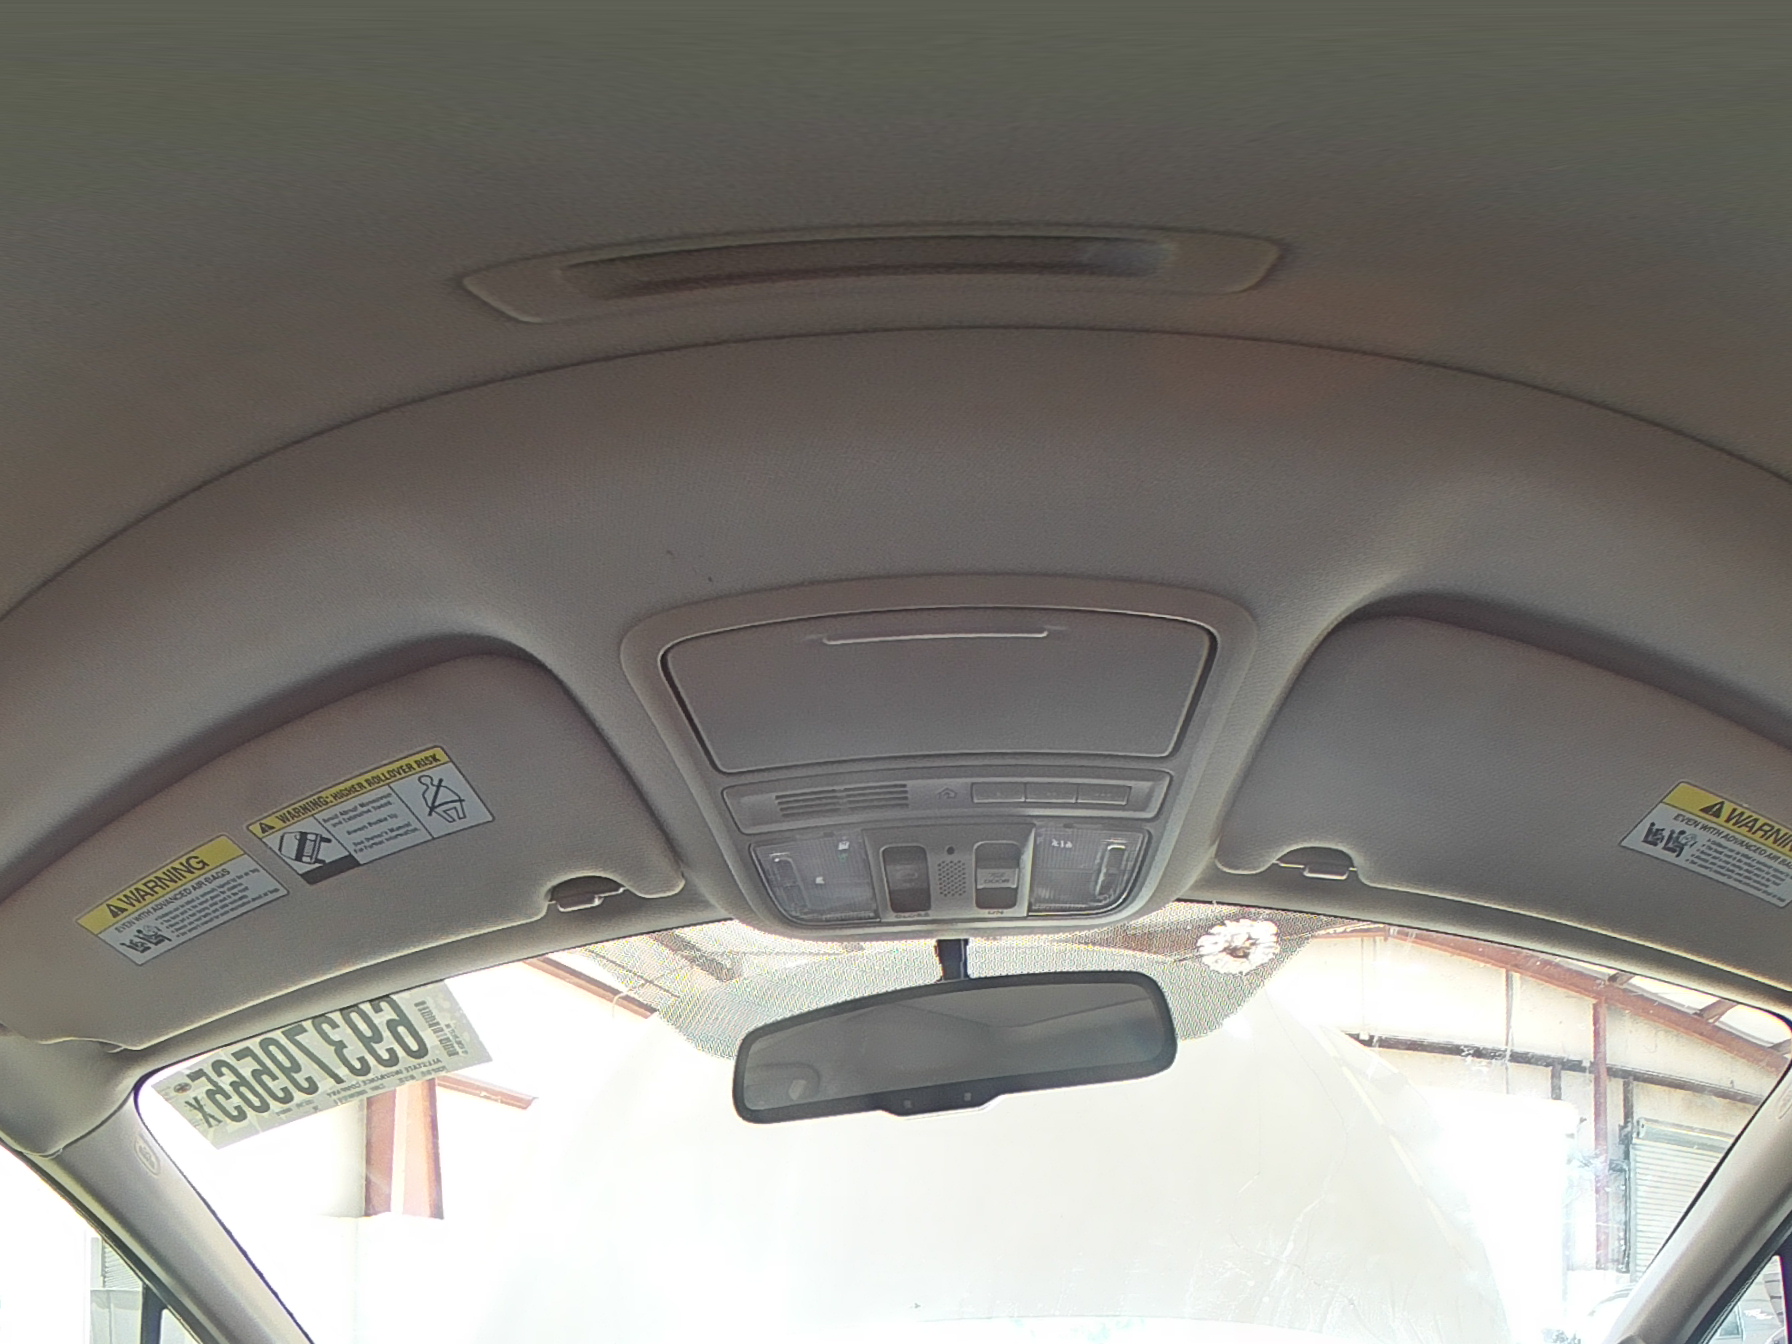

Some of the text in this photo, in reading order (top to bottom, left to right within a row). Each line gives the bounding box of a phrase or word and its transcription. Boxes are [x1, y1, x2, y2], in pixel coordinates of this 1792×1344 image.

[277, 794, 329, 824] WARNING:
[330, 781, 367, 803] HIGHER
[364, 763, 416, 789] ROLLOVER
[416, 753, 441, 769] RISK
[1672, 813, 1700, 828] EVEN
[1697, 823, 1723, 837] WITH
[1719, 832, 1767, 856] ADVANCED
[117, 855, 210, 908] WARNING
[131, 909, 154, 922] WITH
[149, 887, 194, 912] ADVANCED
